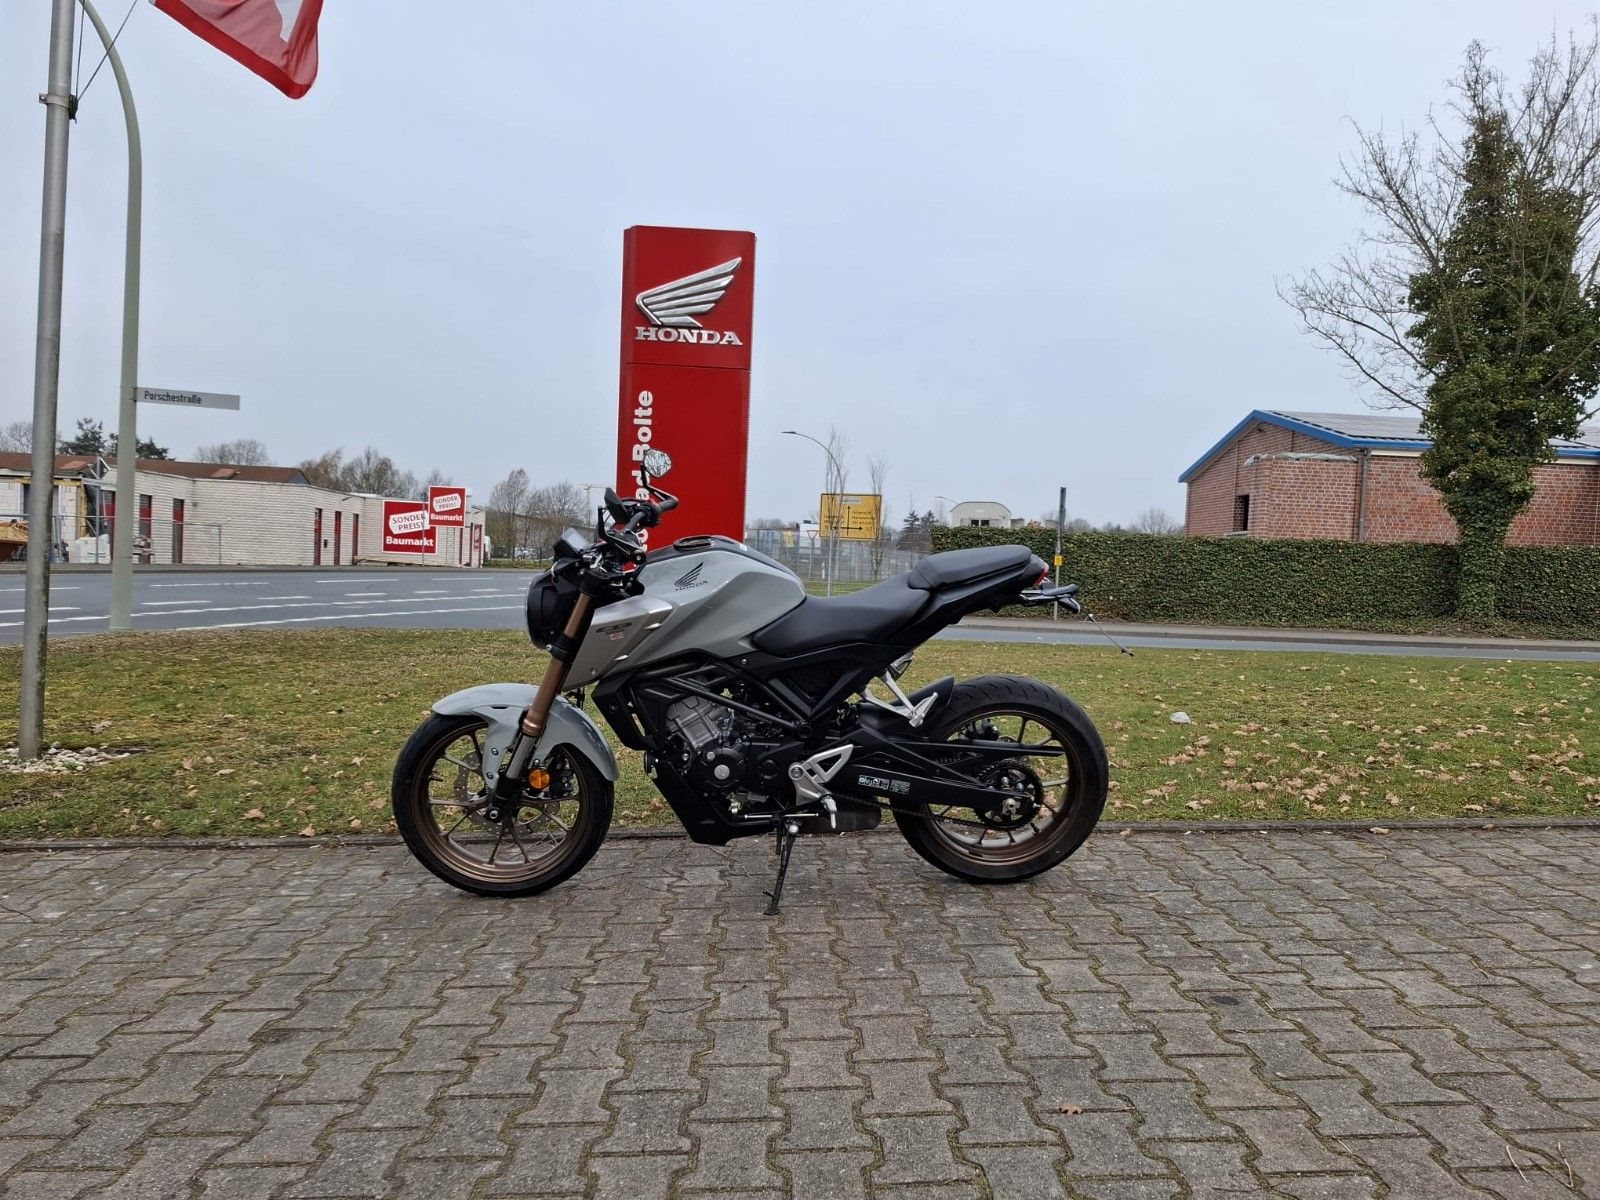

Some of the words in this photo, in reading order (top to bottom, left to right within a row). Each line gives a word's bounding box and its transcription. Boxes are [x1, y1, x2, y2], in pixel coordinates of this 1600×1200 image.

[635, 326, 743, 345] HONDA
[144, 390, 202, 404] Porschestraße
[632, 390, 653, 462] Bolte
[435, 496, 458, 504] SONDER
[392, 513, 426, 524] SONDER
[430, 513, 463, 521] Baumarkt
[386, 536, 434, 546] Baumarkt
